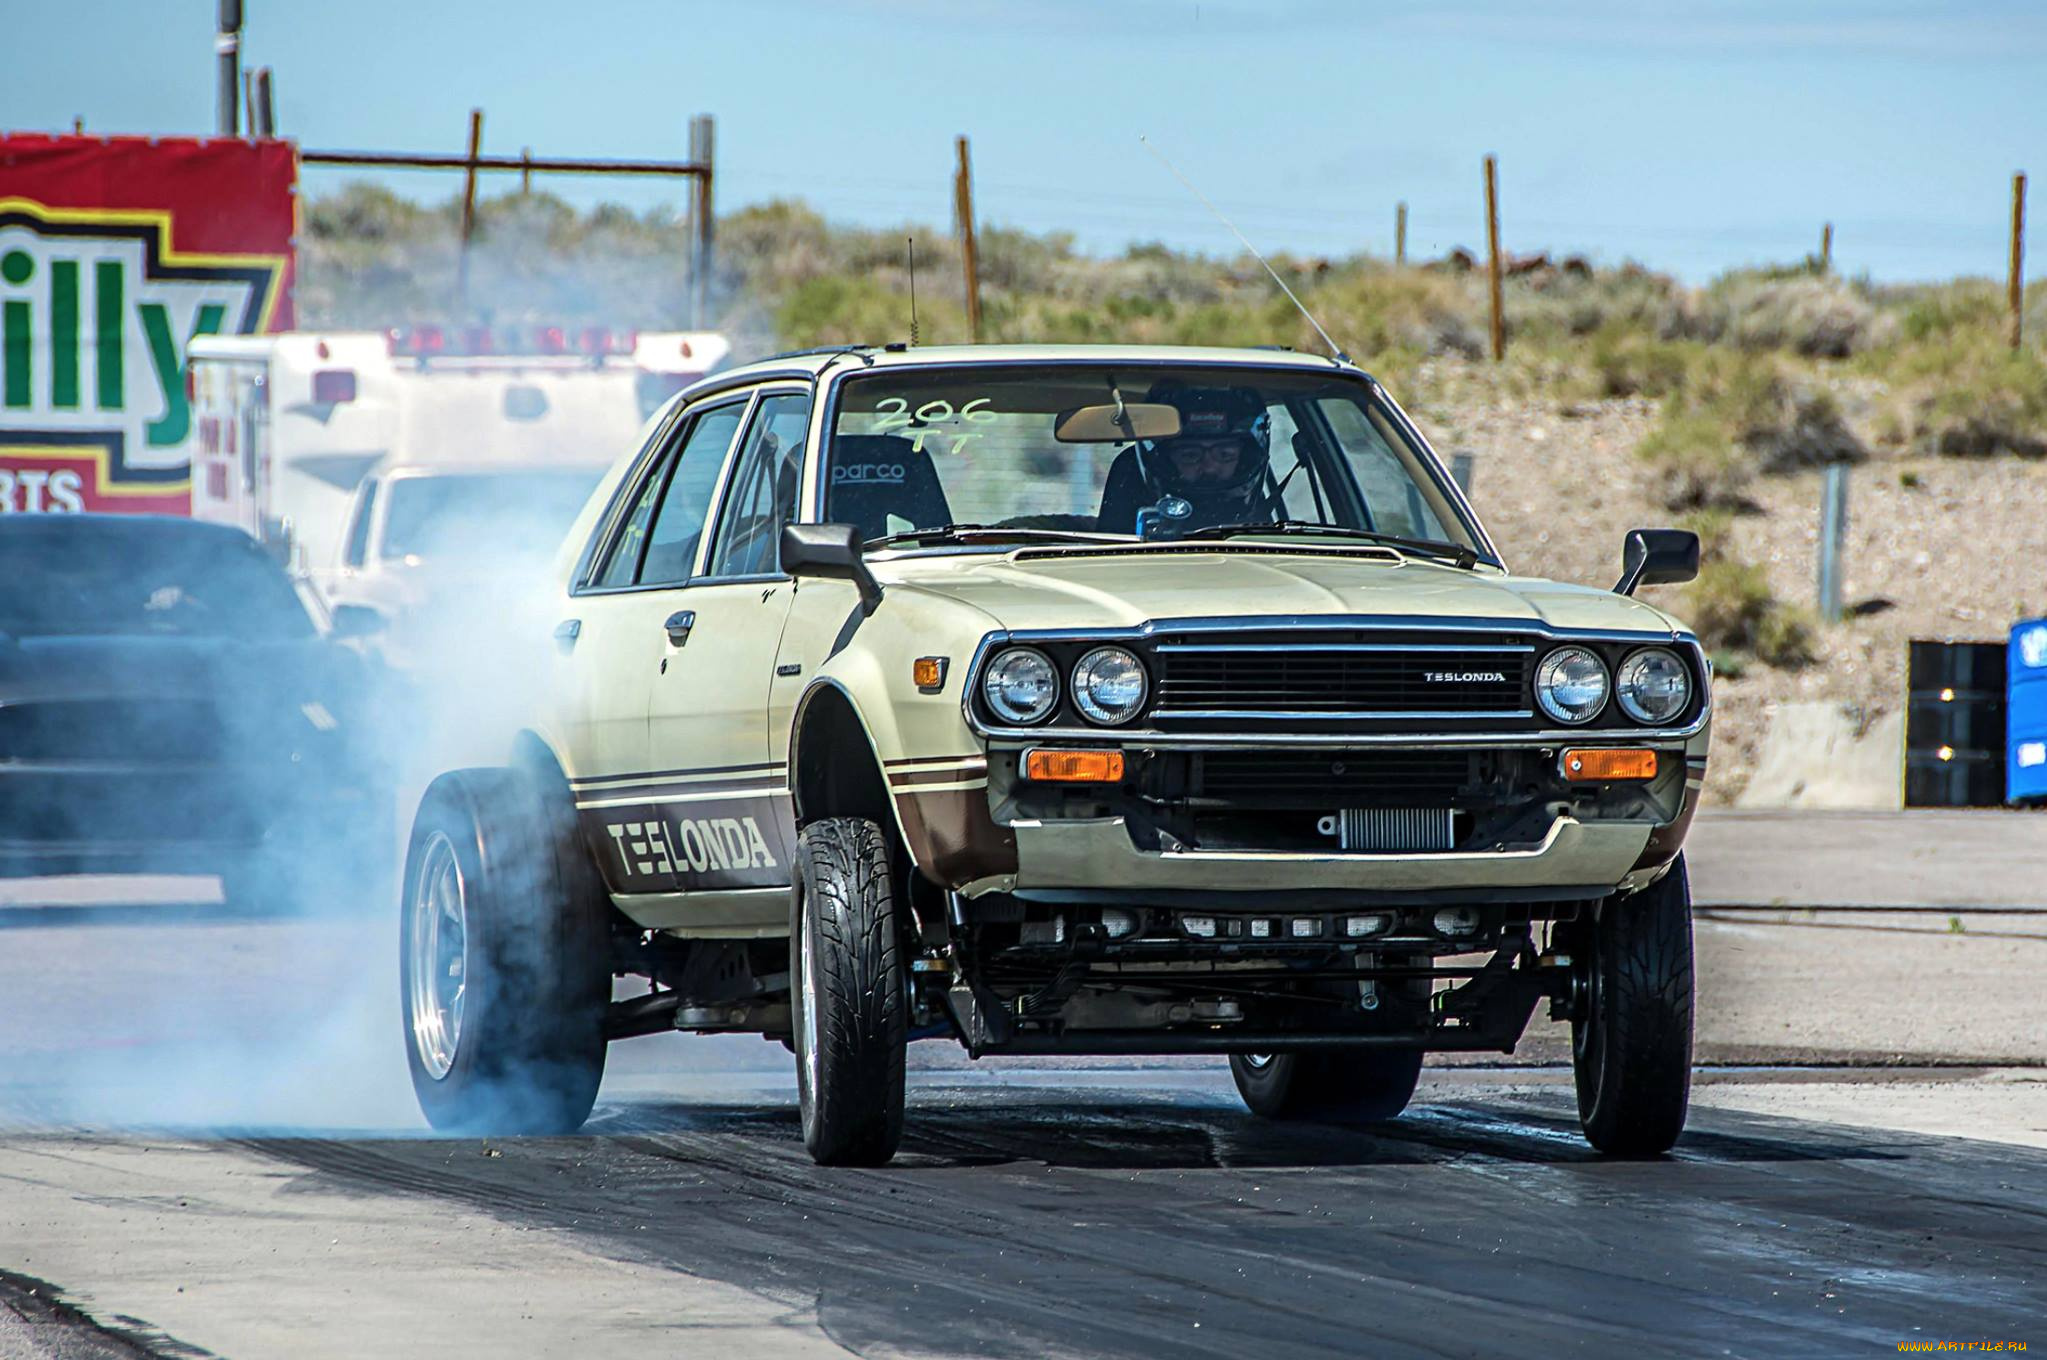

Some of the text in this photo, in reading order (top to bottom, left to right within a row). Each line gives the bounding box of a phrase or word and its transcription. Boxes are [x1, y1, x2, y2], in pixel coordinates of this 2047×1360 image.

[871, 397, 999, 431] 206
[1424, 672, 1506, 682] TESLONDA
[607, 817, 778, 876] TESLONDA
